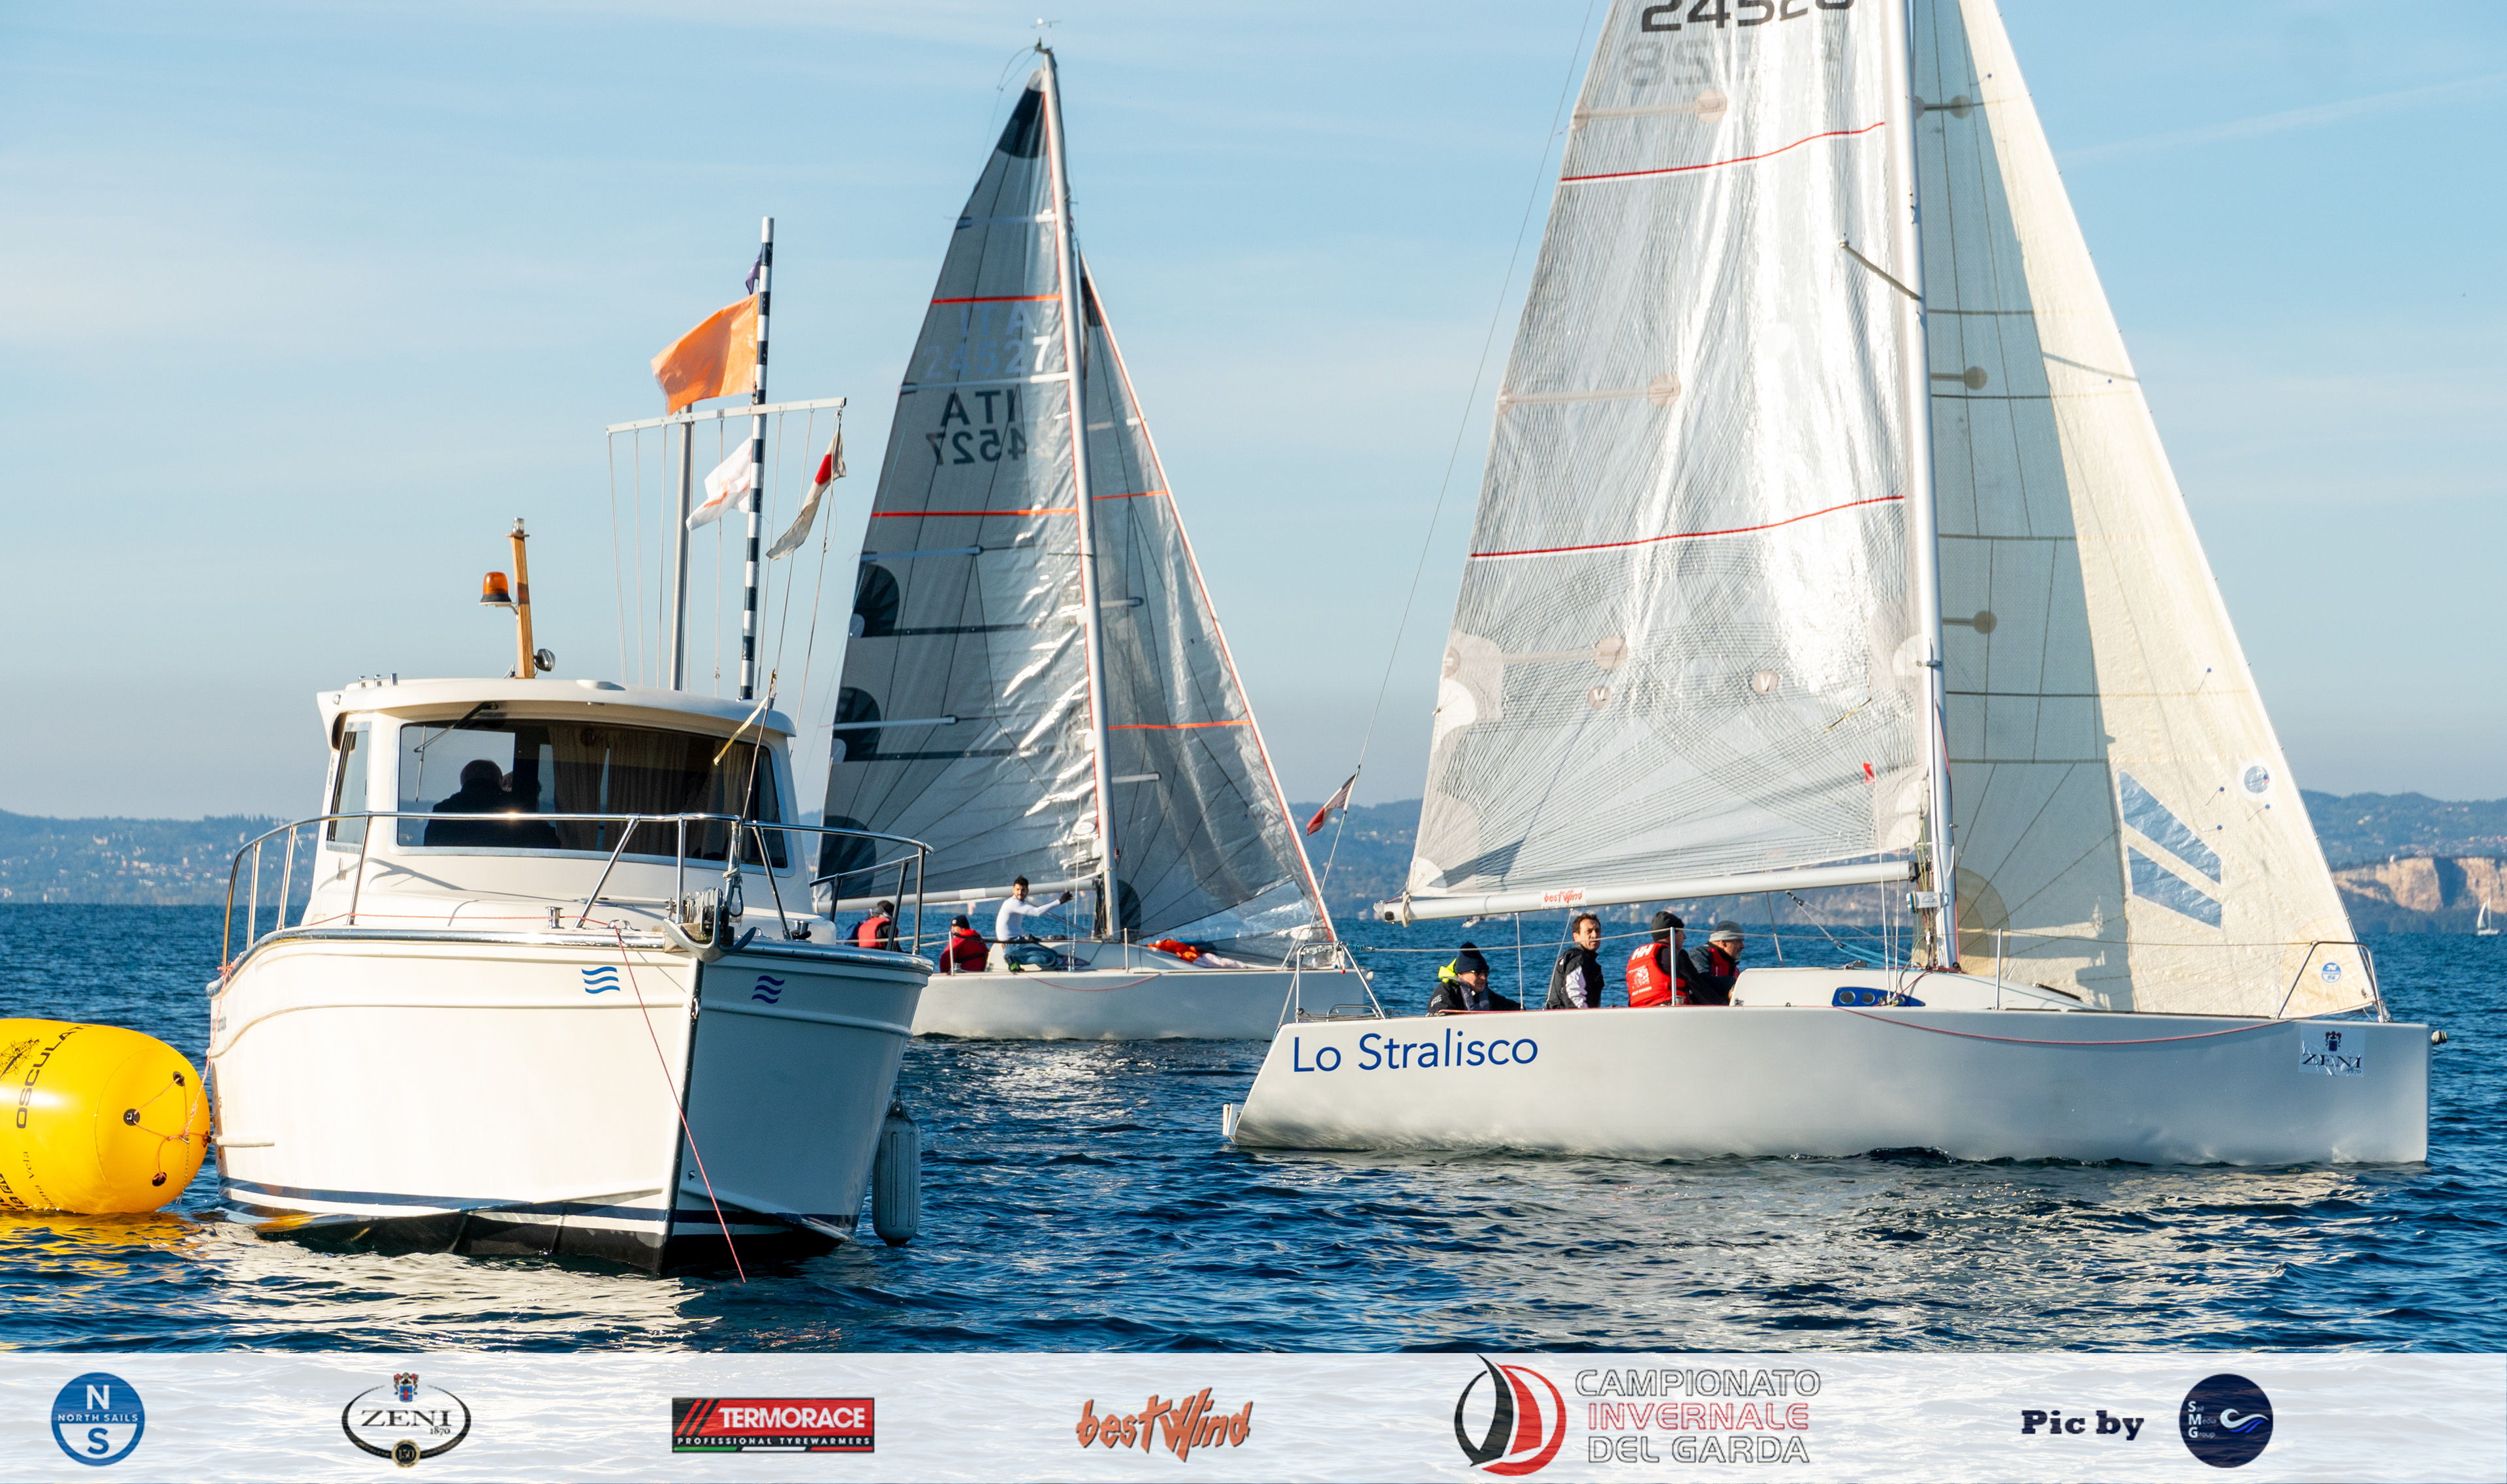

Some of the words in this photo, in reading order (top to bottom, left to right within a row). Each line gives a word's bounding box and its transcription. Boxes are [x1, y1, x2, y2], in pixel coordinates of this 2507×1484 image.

[960, 301, 1037, 338] ITA
[923, 335, 1050, 379] 24527
[1293, 1036, 1341, 1072] Lo
[1358, 1028, 1538, 1070] Stralisco
